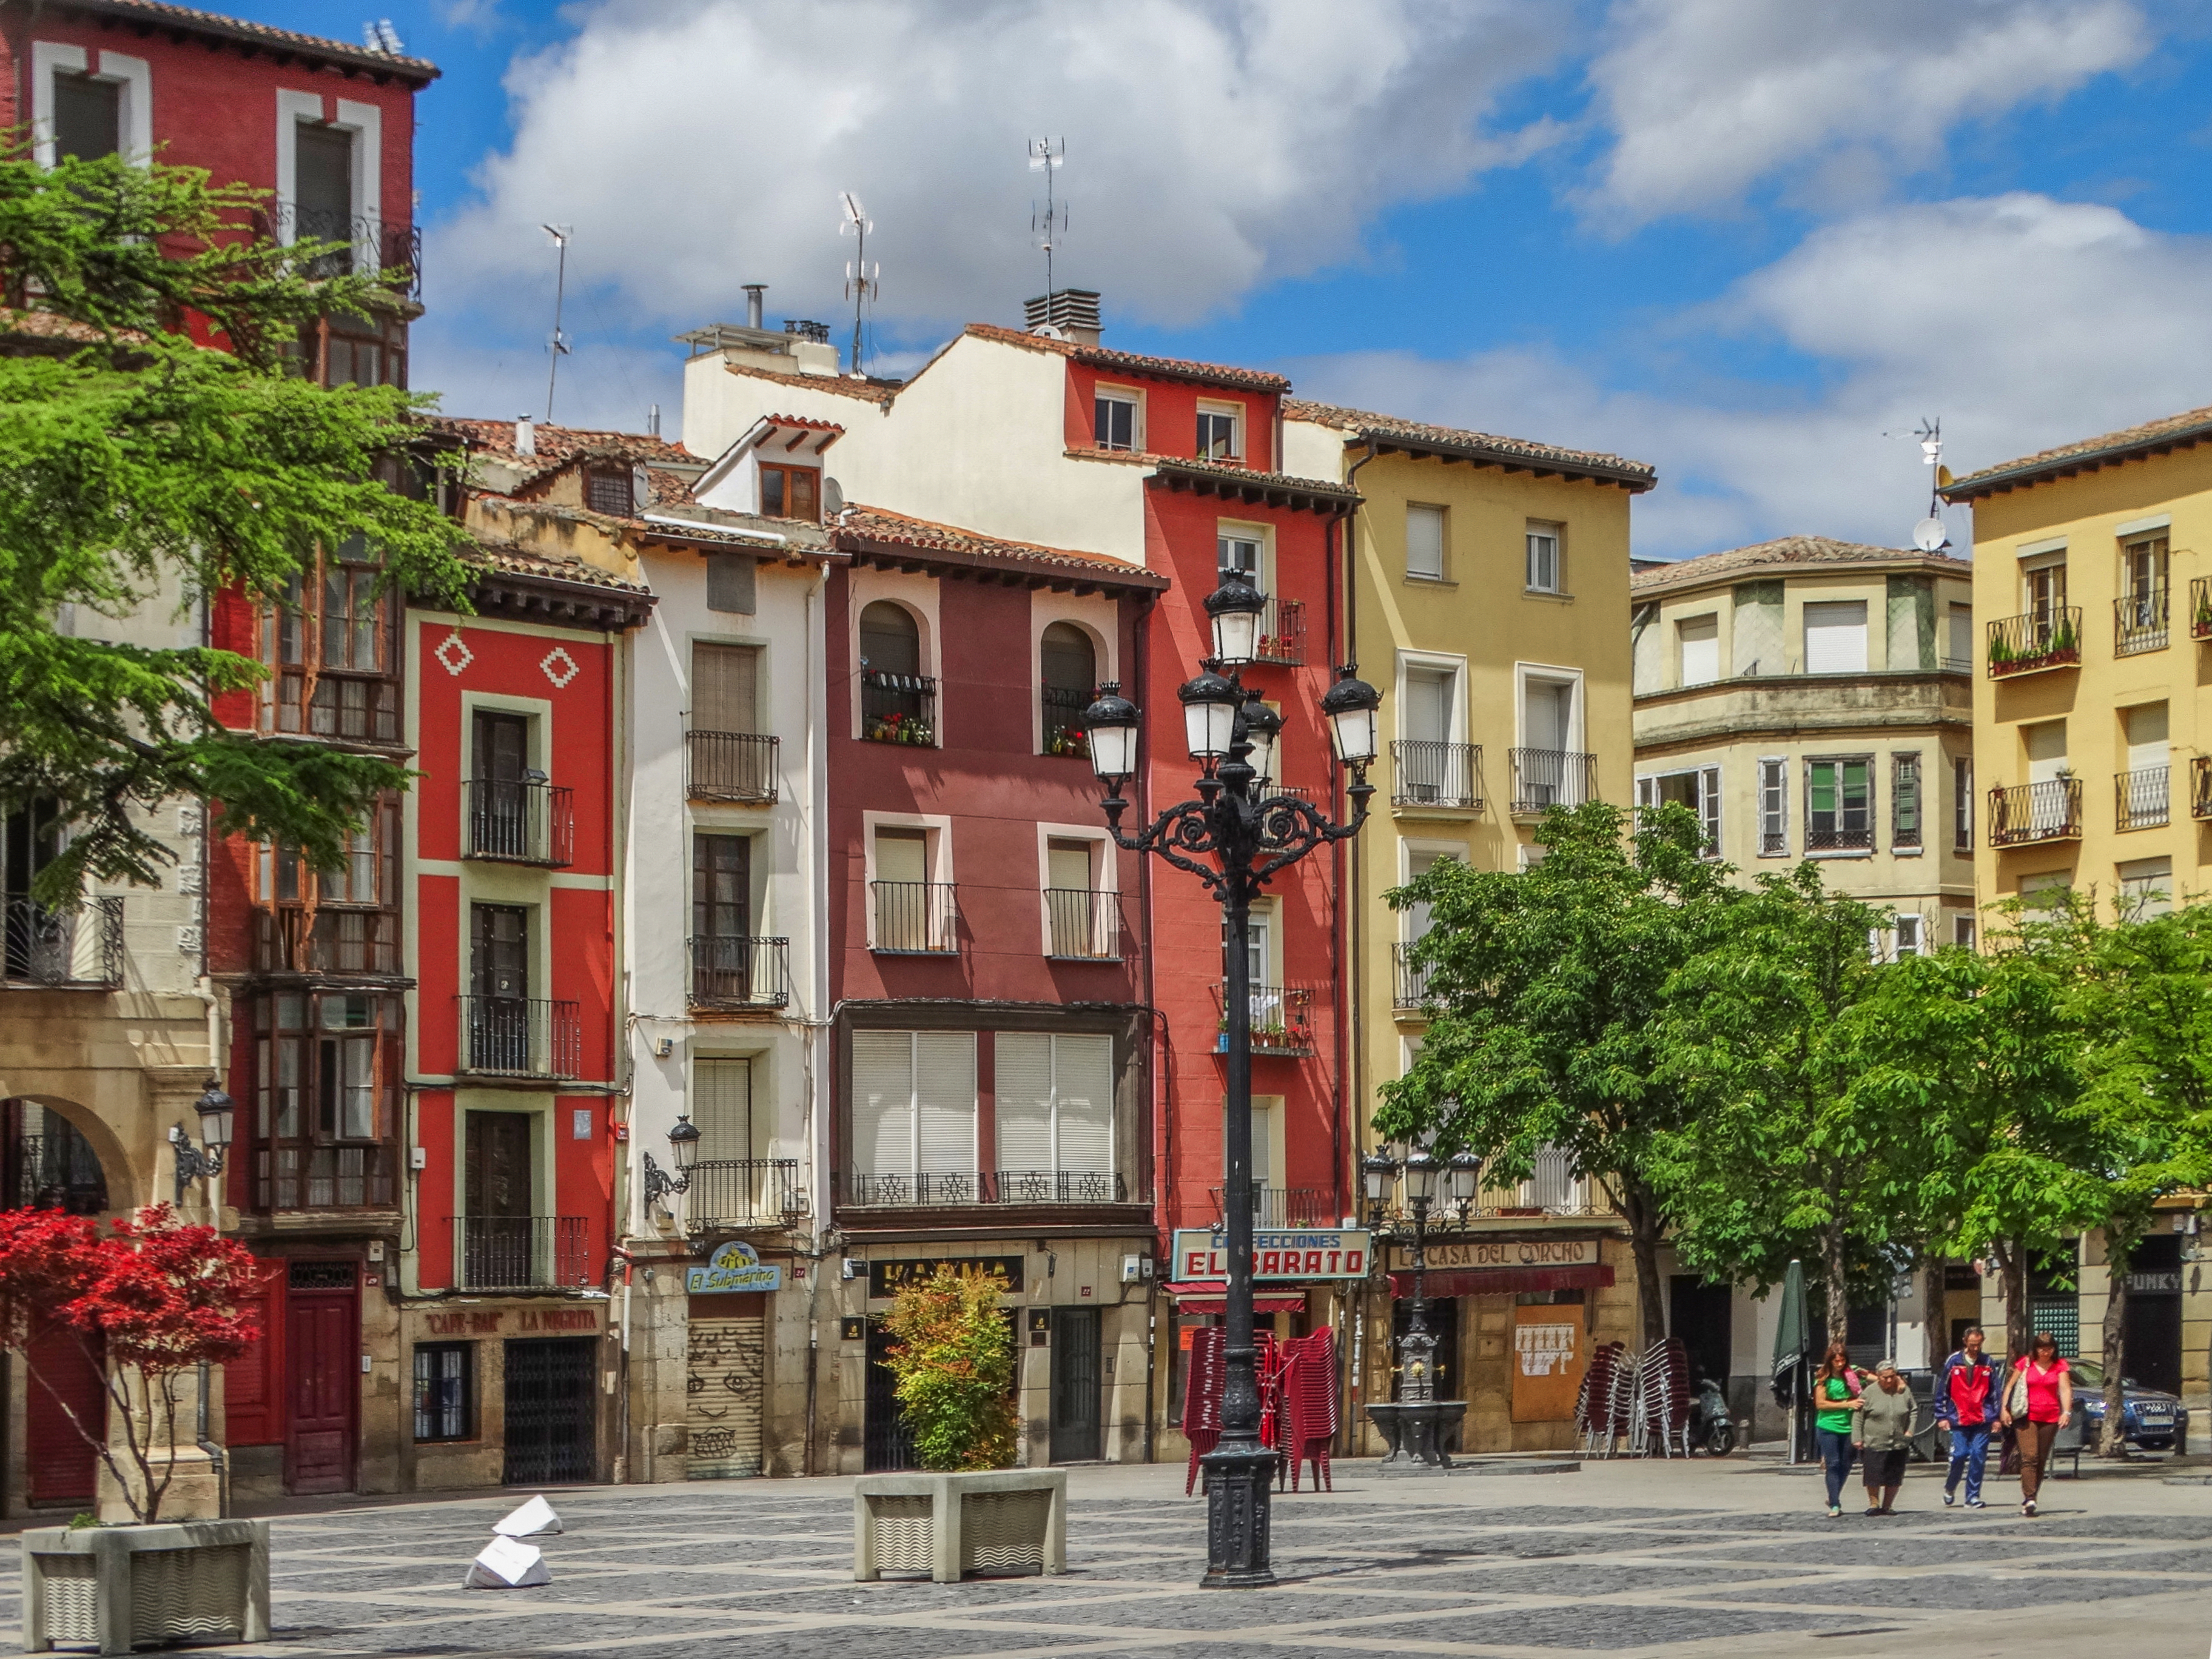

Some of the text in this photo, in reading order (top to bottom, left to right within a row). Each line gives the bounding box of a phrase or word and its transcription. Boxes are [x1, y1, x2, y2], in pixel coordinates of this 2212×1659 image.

[1211, 1235, 1341, 1250] CECCIONES
[1427, 1245, 1473, 1265] CASA
[1477, 1244, 1512, 1265] DEL
[1518, 1242, 1585, 1264] CORCHO
[1185, 1252, 1226, 1276] EL
[690, 1268, 775, 1291] El Submarino
[520, 1310, 539, 1331] LA
[542, 1309, 597, 1330] NEGRITA
